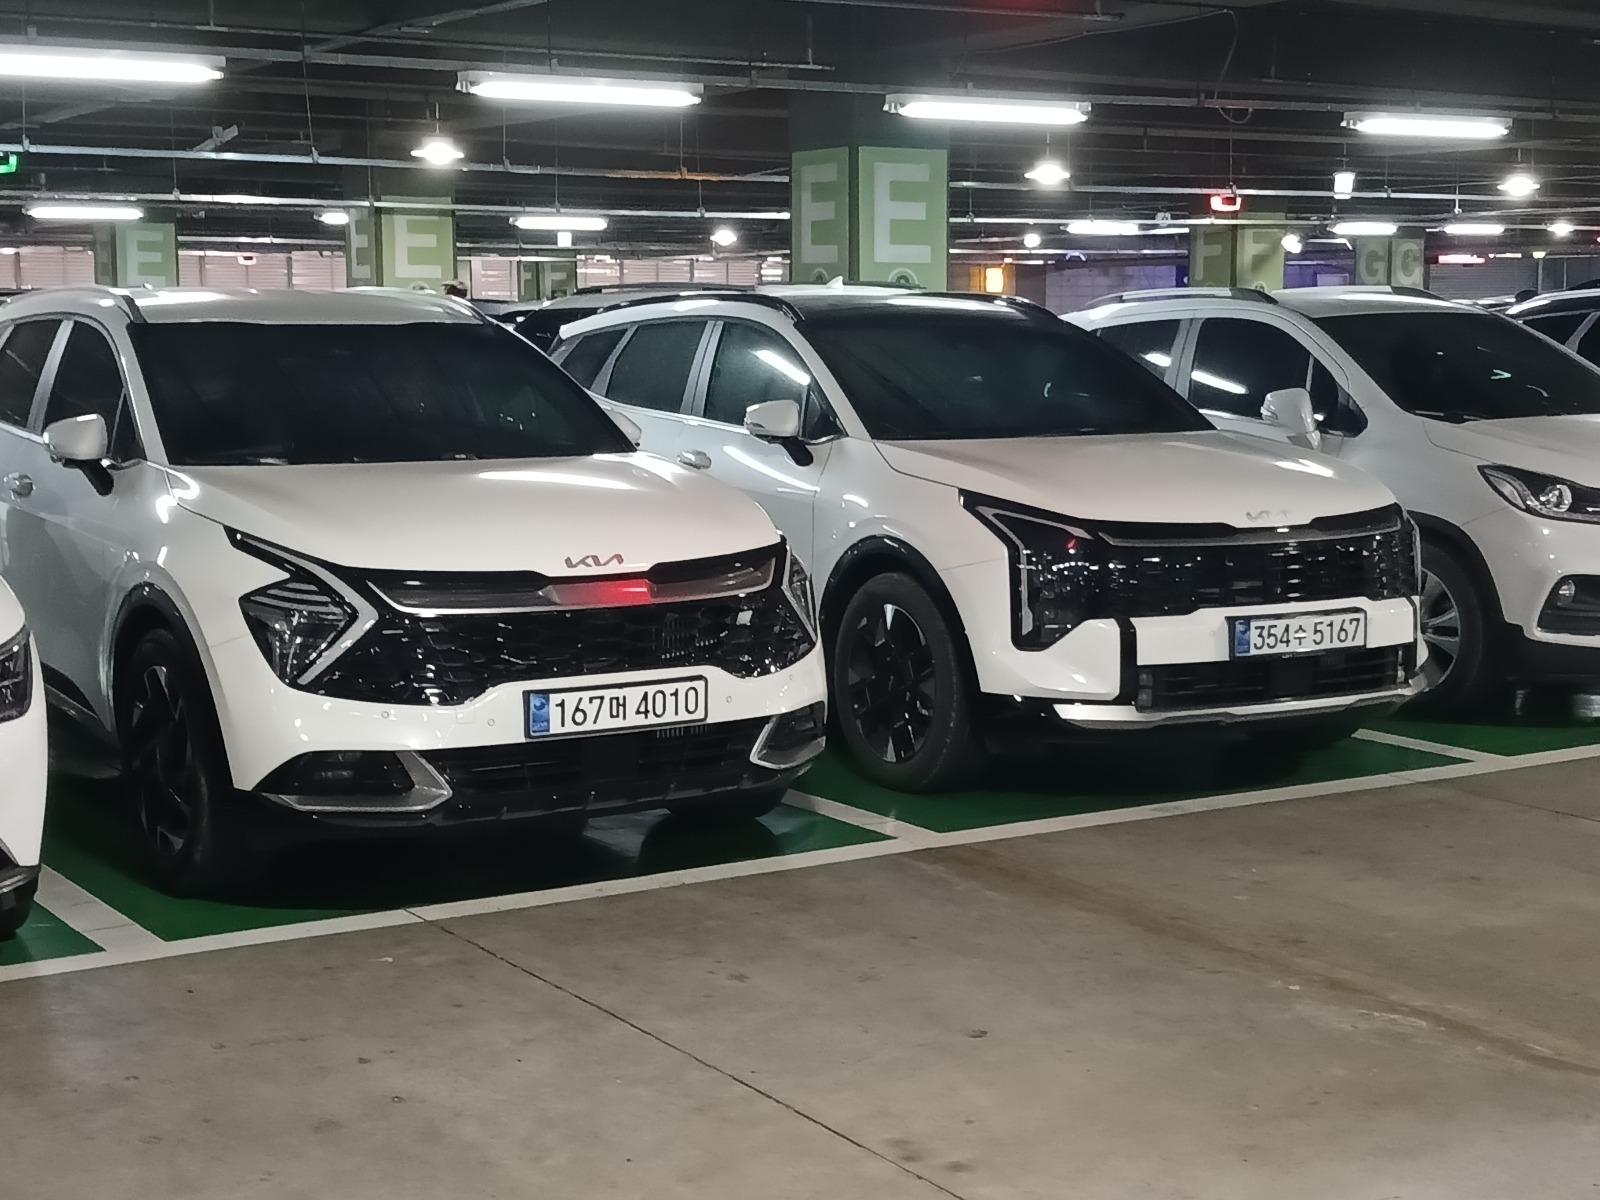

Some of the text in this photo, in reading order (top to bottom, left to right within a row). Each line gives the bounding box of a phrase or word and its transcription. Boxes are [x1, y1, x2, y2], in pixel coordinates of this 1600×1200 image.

[801, 161, 839, 264] E
[874, 162, 932, 264] E
[126, 230, 166, 288] E
[350, 207, 371, 279] E
[394, 213, 442, 279] E
[1194, 226, 1228, 281] F
[565, 553, 624, 568] KIA
[1253, 624, 1307, 650] 354수
[1312, 618, 1360, 646] 5167
[555, 686, 699, 728] 167머 4010
